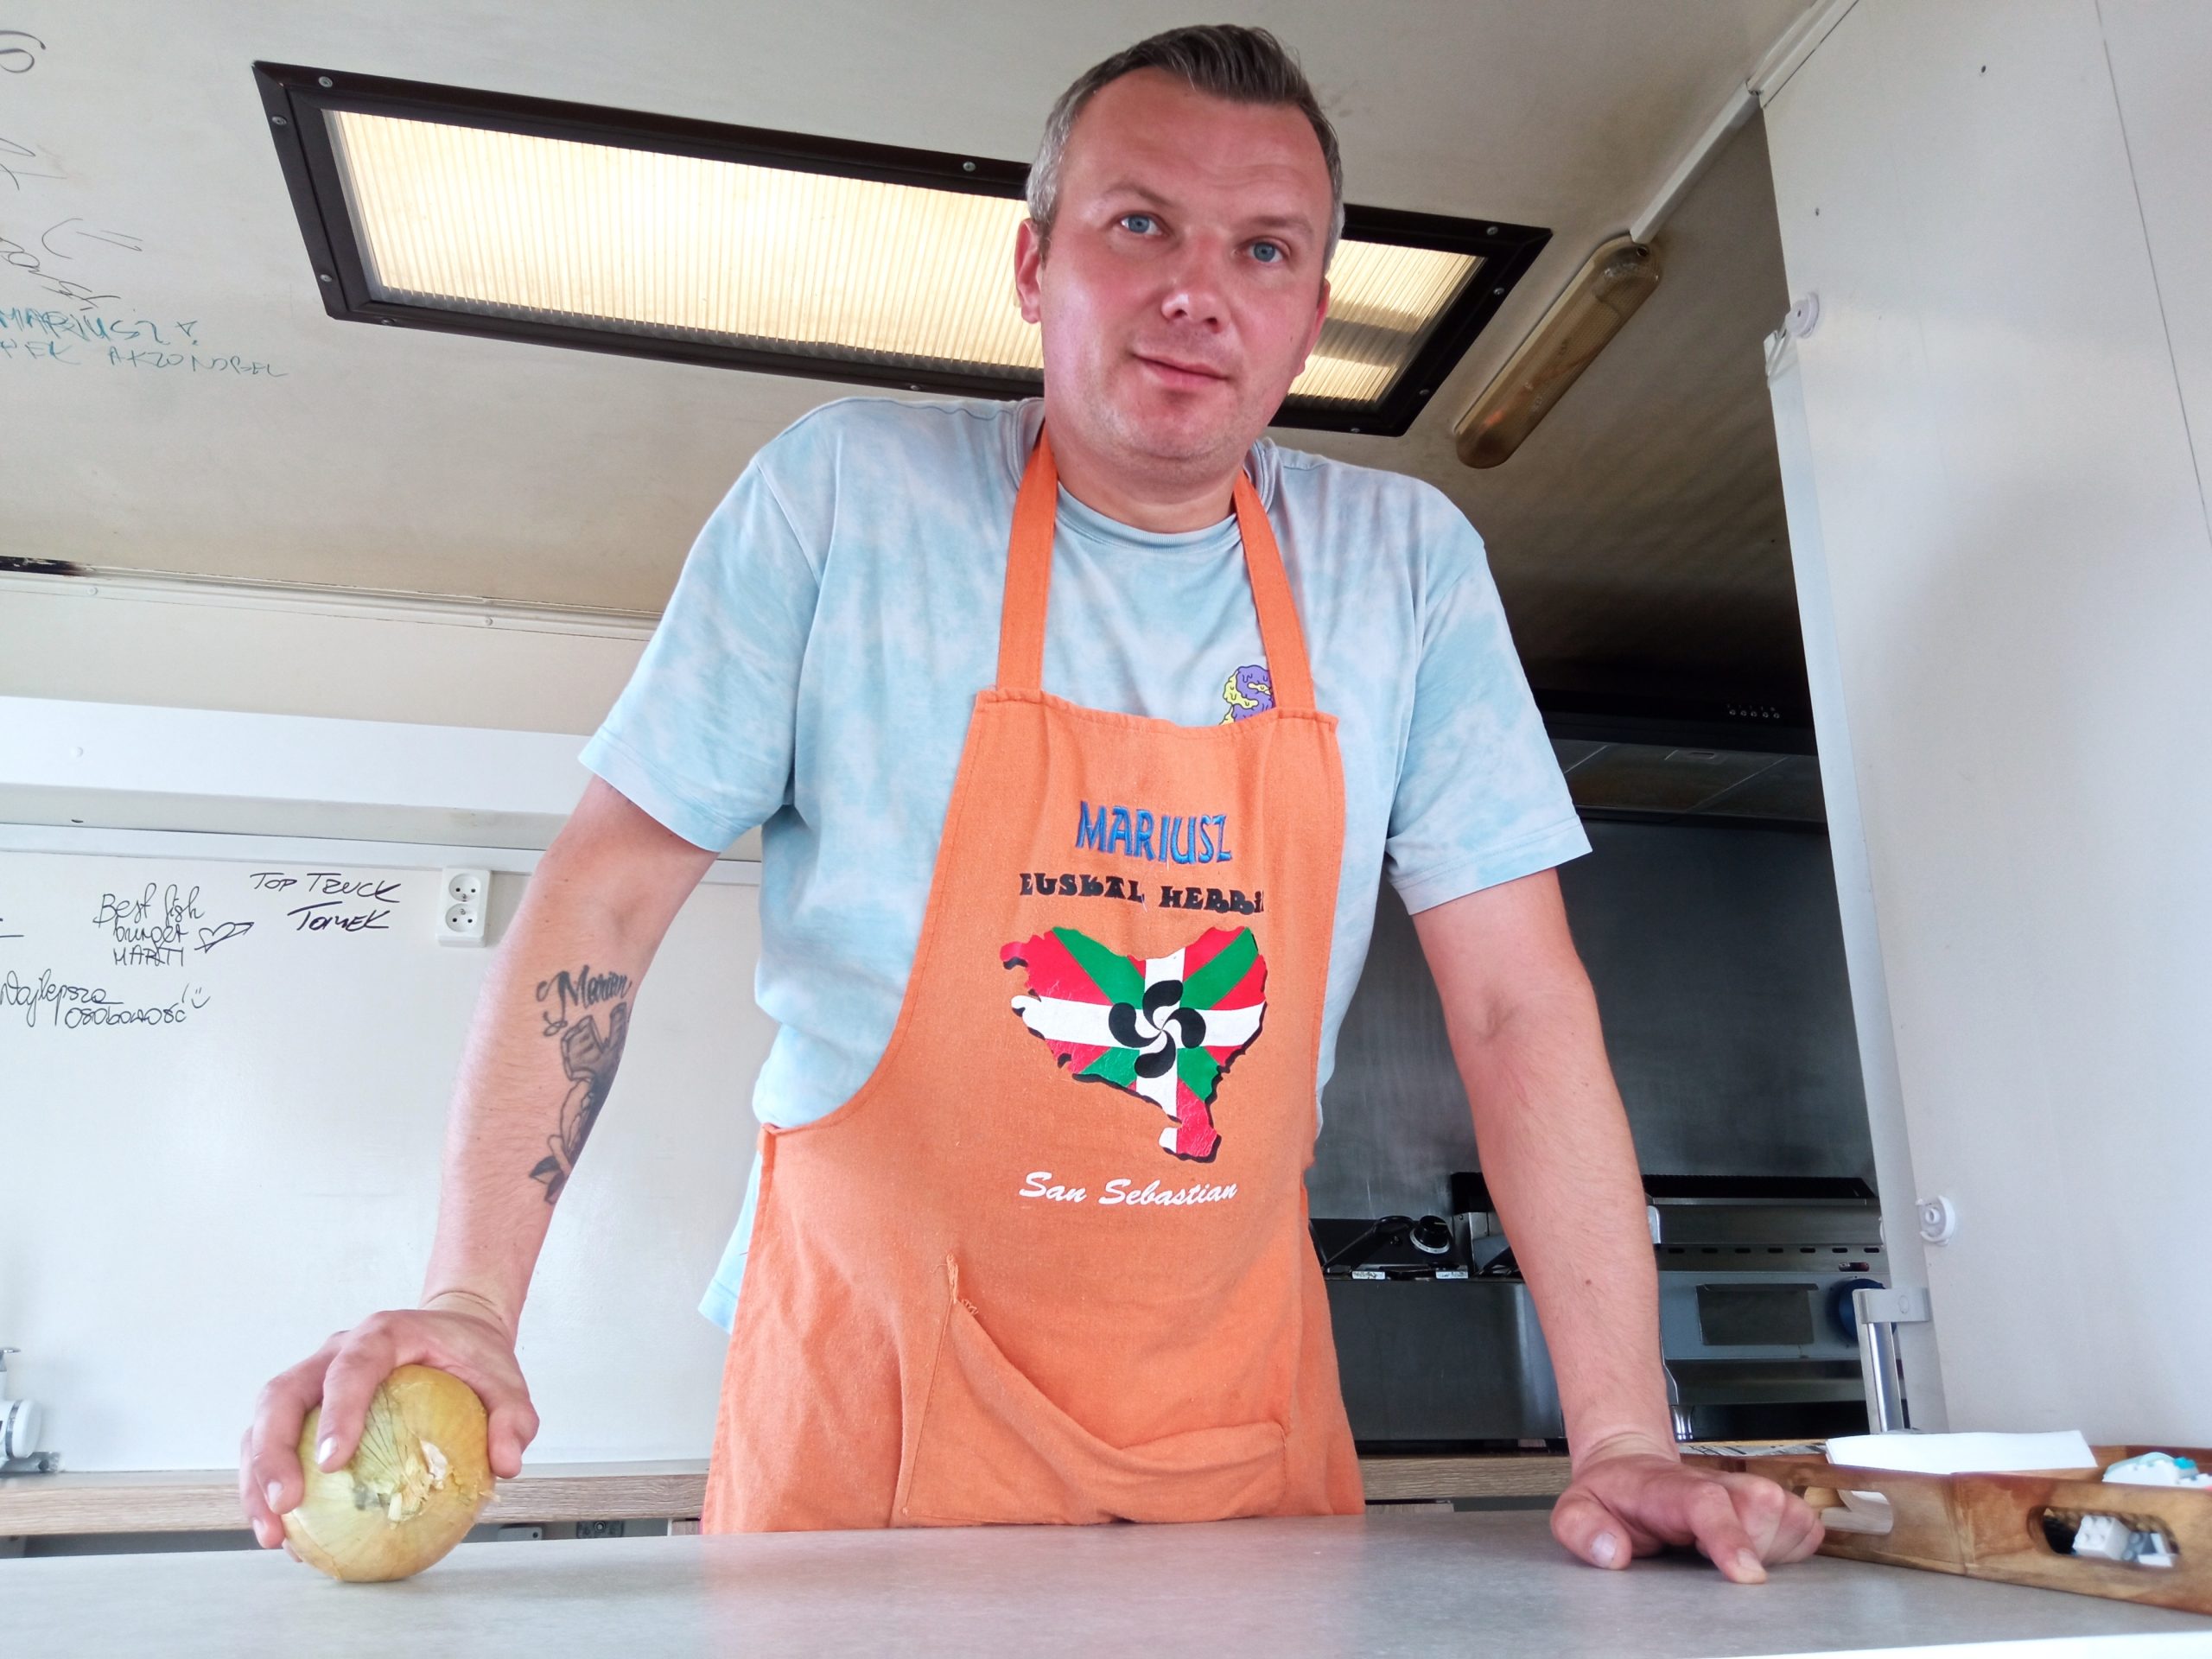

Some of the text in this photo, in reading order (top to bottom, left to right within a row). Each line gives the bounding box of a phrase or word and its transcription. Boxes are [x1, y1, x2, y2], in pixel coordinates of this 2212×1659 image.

[1076, 800, 1232, 864] MARIUSZ
[92, 882, 206, 928] Best fish
[1019, 873, 1144, 904] EUSKAL
[1019, 1172, 1237, 1206] San Sebastian
